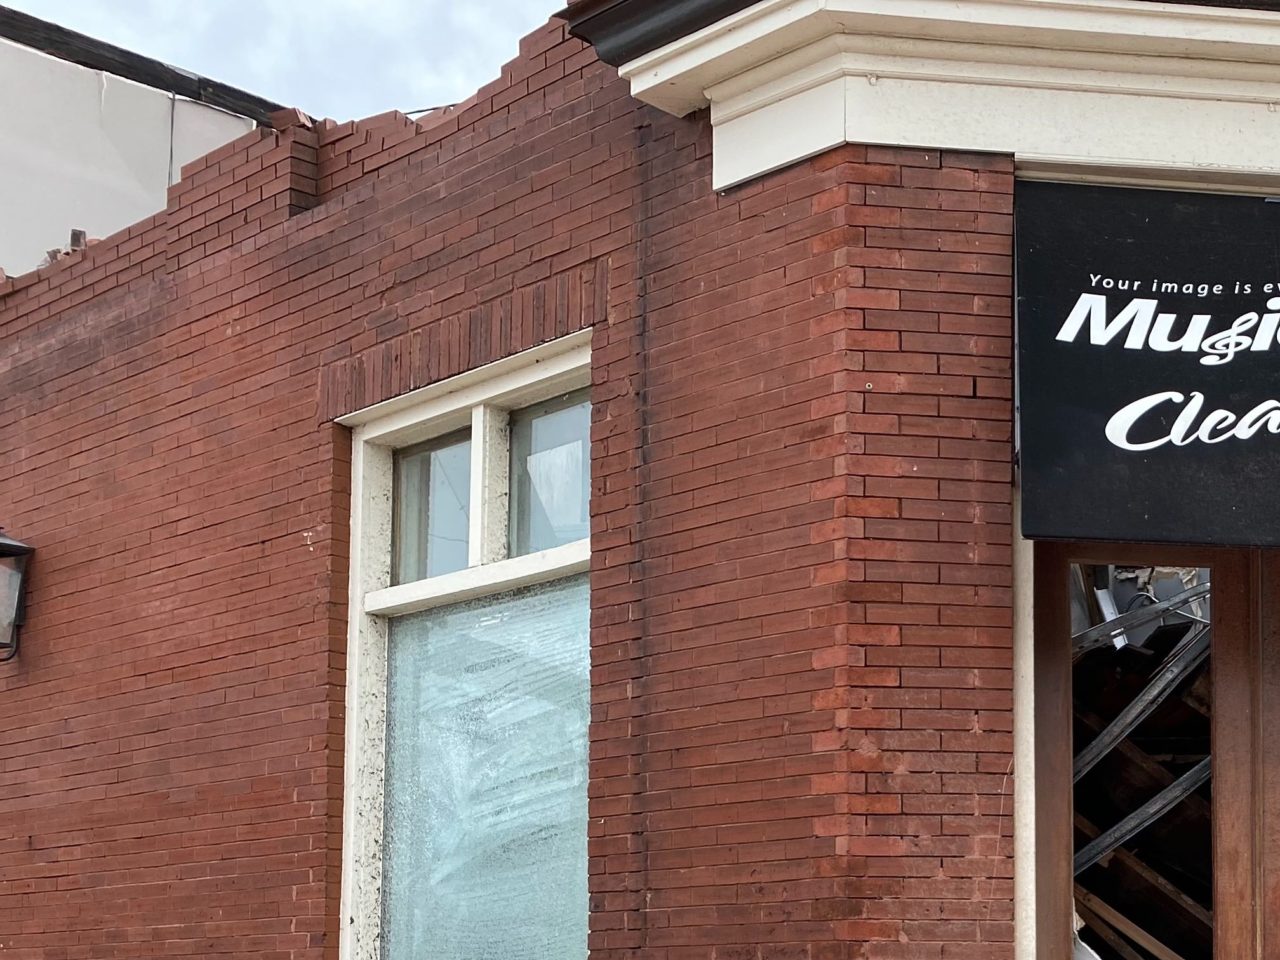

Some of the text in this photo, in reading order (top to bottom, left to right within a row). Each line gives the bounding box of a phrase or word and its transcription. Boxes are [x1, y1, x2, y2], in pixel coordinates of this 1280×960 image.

[1089, 273, 1142, 291] Your
[1151, 279, 1223, 298] image
[1234, 281, 1252, 295] is
